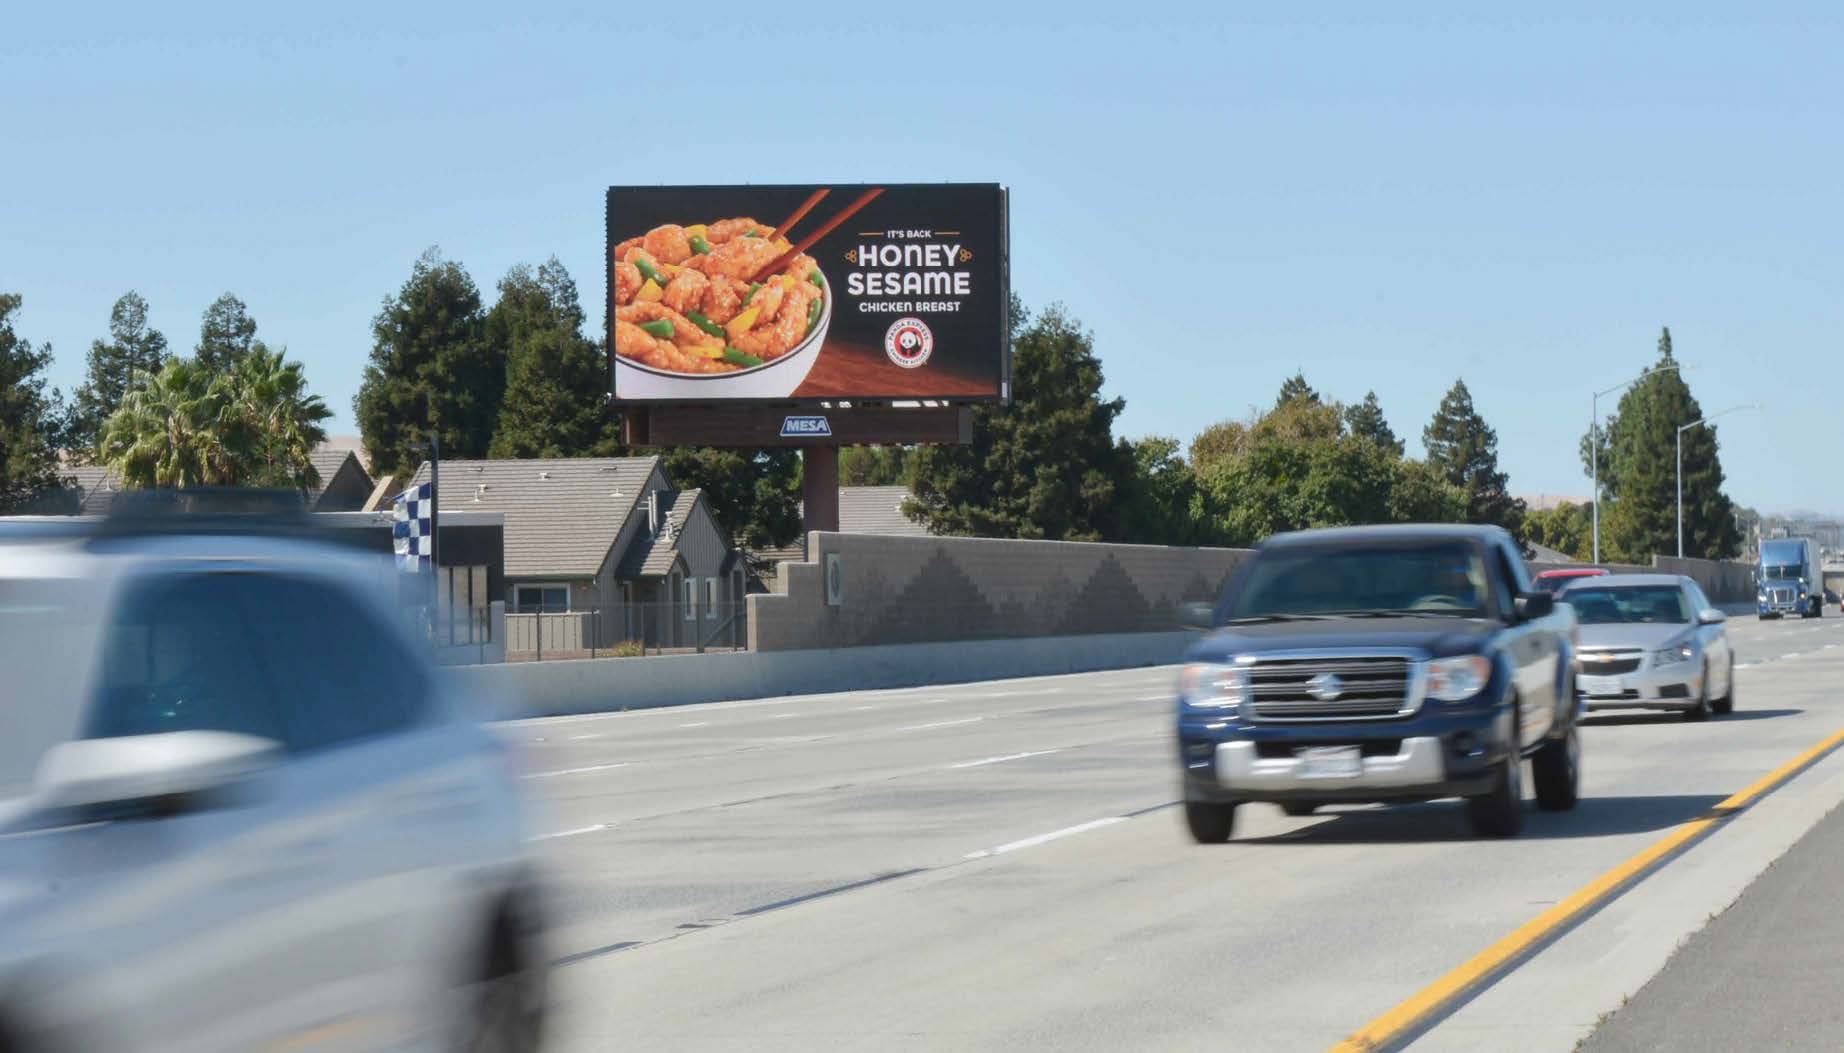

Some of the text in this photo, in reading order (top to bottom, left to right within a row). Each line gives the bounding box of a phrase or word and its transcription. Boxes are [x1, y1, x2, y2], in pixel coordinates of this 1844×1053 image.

[887, 230, 931, 238] IT'S BACK
[859, 244, 961, 267] HONEY
[848, 271, 971, 295] SESAME
[859, 301, 961, 312] CHICKEN BREAST
[786, 420, 828, 431] MESA
